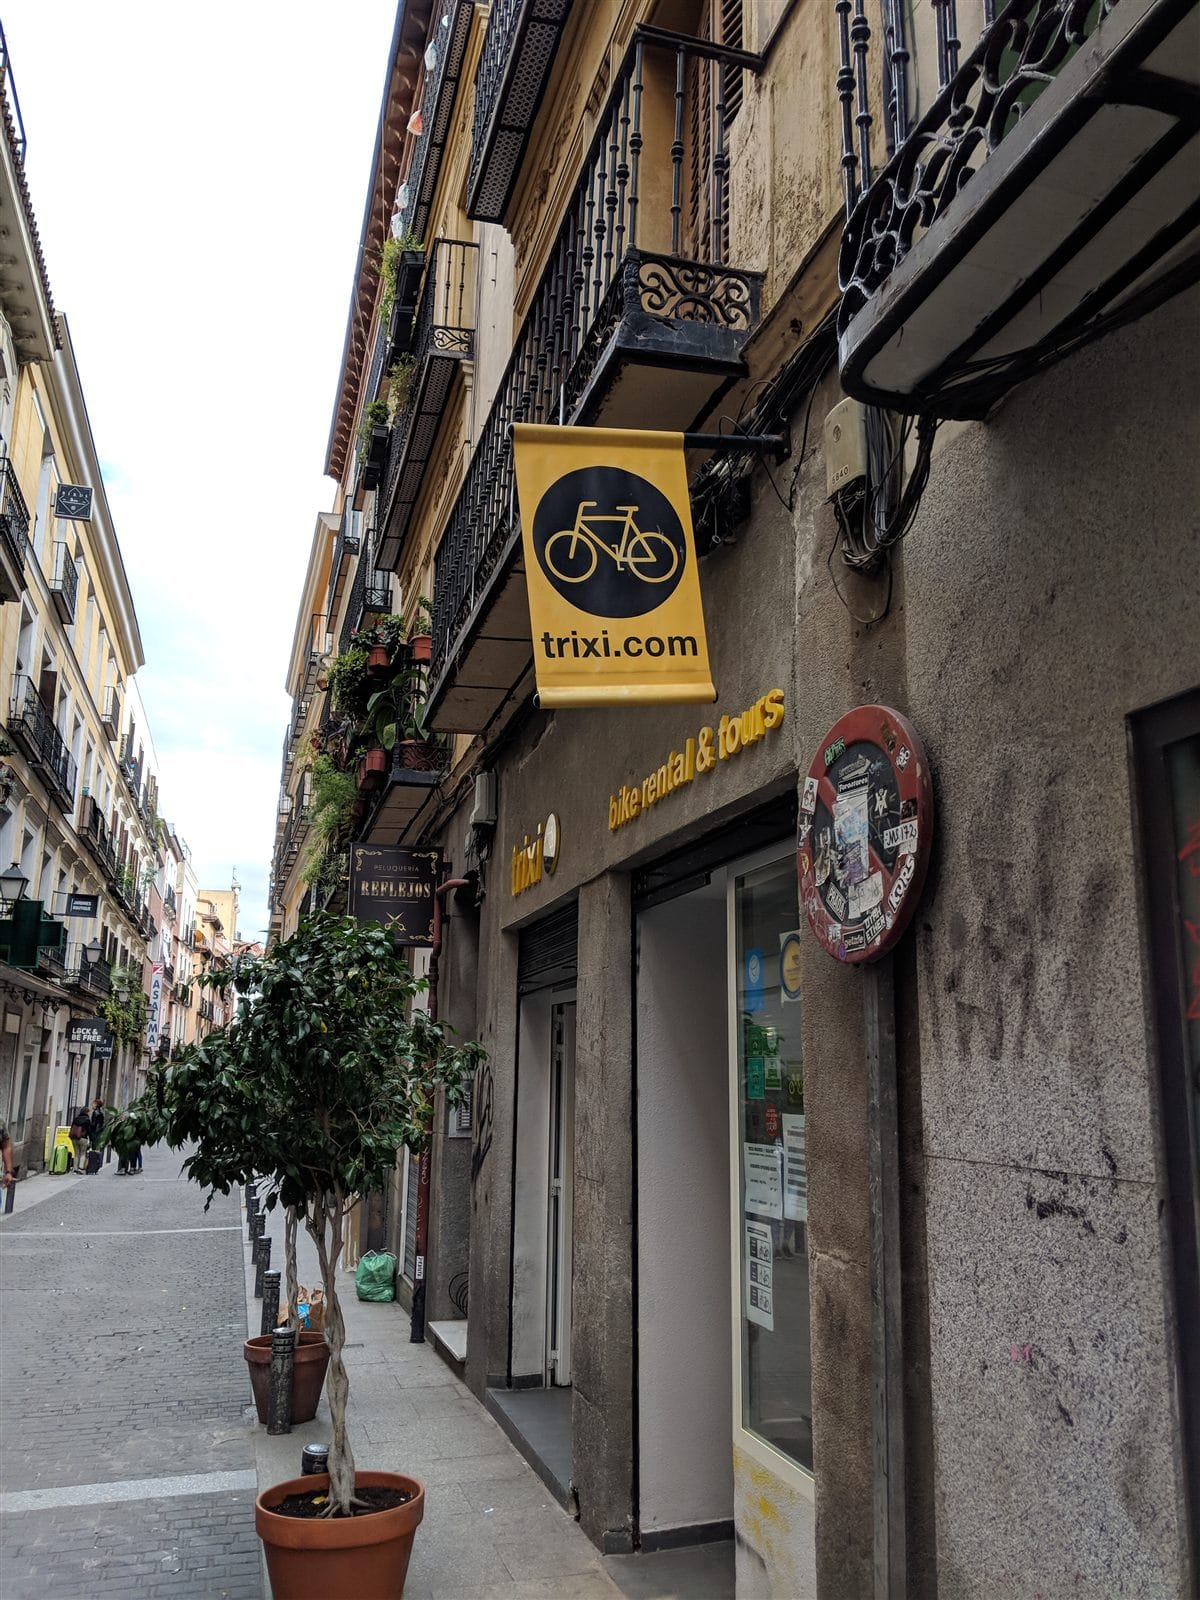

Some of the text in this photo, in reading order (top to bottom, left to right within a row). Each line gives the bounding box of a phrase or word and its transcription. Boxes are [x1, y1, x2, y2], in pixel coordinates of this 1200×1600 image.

[541, 630, 698, 658] trixi.com
[608, 785, 641, 832] bike
[641, 738, 695, 810] rental
[696, 726, 716, 773] &
[717, 688, 785, 760] tours
[511, 823, 543, 896] trixi
[360, 880, 431, 898] REFLEJOS
[866, 917, 886, 942] ETHER
